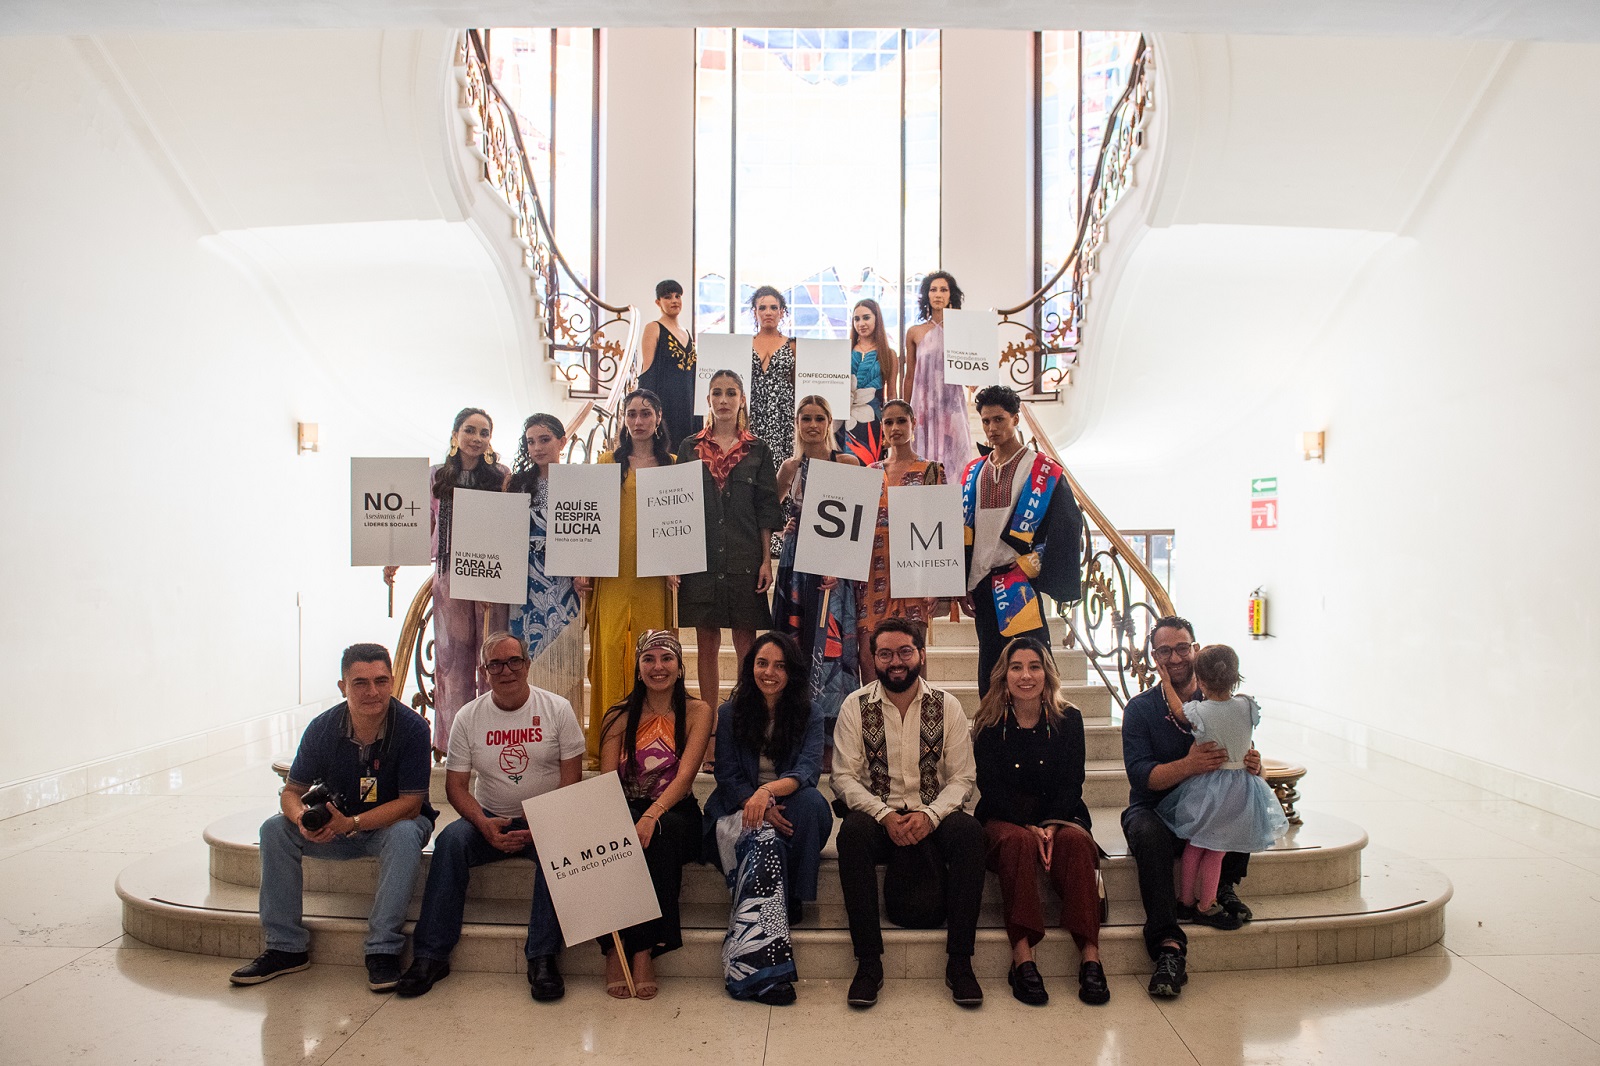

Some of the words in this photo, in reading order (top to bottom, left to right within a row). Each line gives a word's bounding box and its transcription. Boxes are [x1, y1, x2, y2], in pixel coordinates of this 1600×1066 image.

[947, 360, 989, 370] TODAS
[555, 500, 582, 512] AQUÍ
[584, 502, 598, 511] SE
[647, 492, 694, 508] FASHION
[555, 512, 602, 522] RESPIRA
[813, 500, 863, 542] SI
[554, 522, 601, 535] LUCHA
[652, 524, 692, 538] FACHO
[910, 521, 943, 550] M
[456, 558, 486, 569] PARA
[488, 560, 502, 570] LA
[896, 558, 959, 568] MANIFIESTA
[455, 566, 502, 579] GUERRA
[994, 578, 1010, 610] 2016
[486, 728, 543, 746] COMUNES
[551, 856, 572, 870] LA
[580, 837, 632, 861] MODA
[556, 872, 566, 880] Es
[568, 868, 580, 876] un
[582, 860, 600, 872] acto
